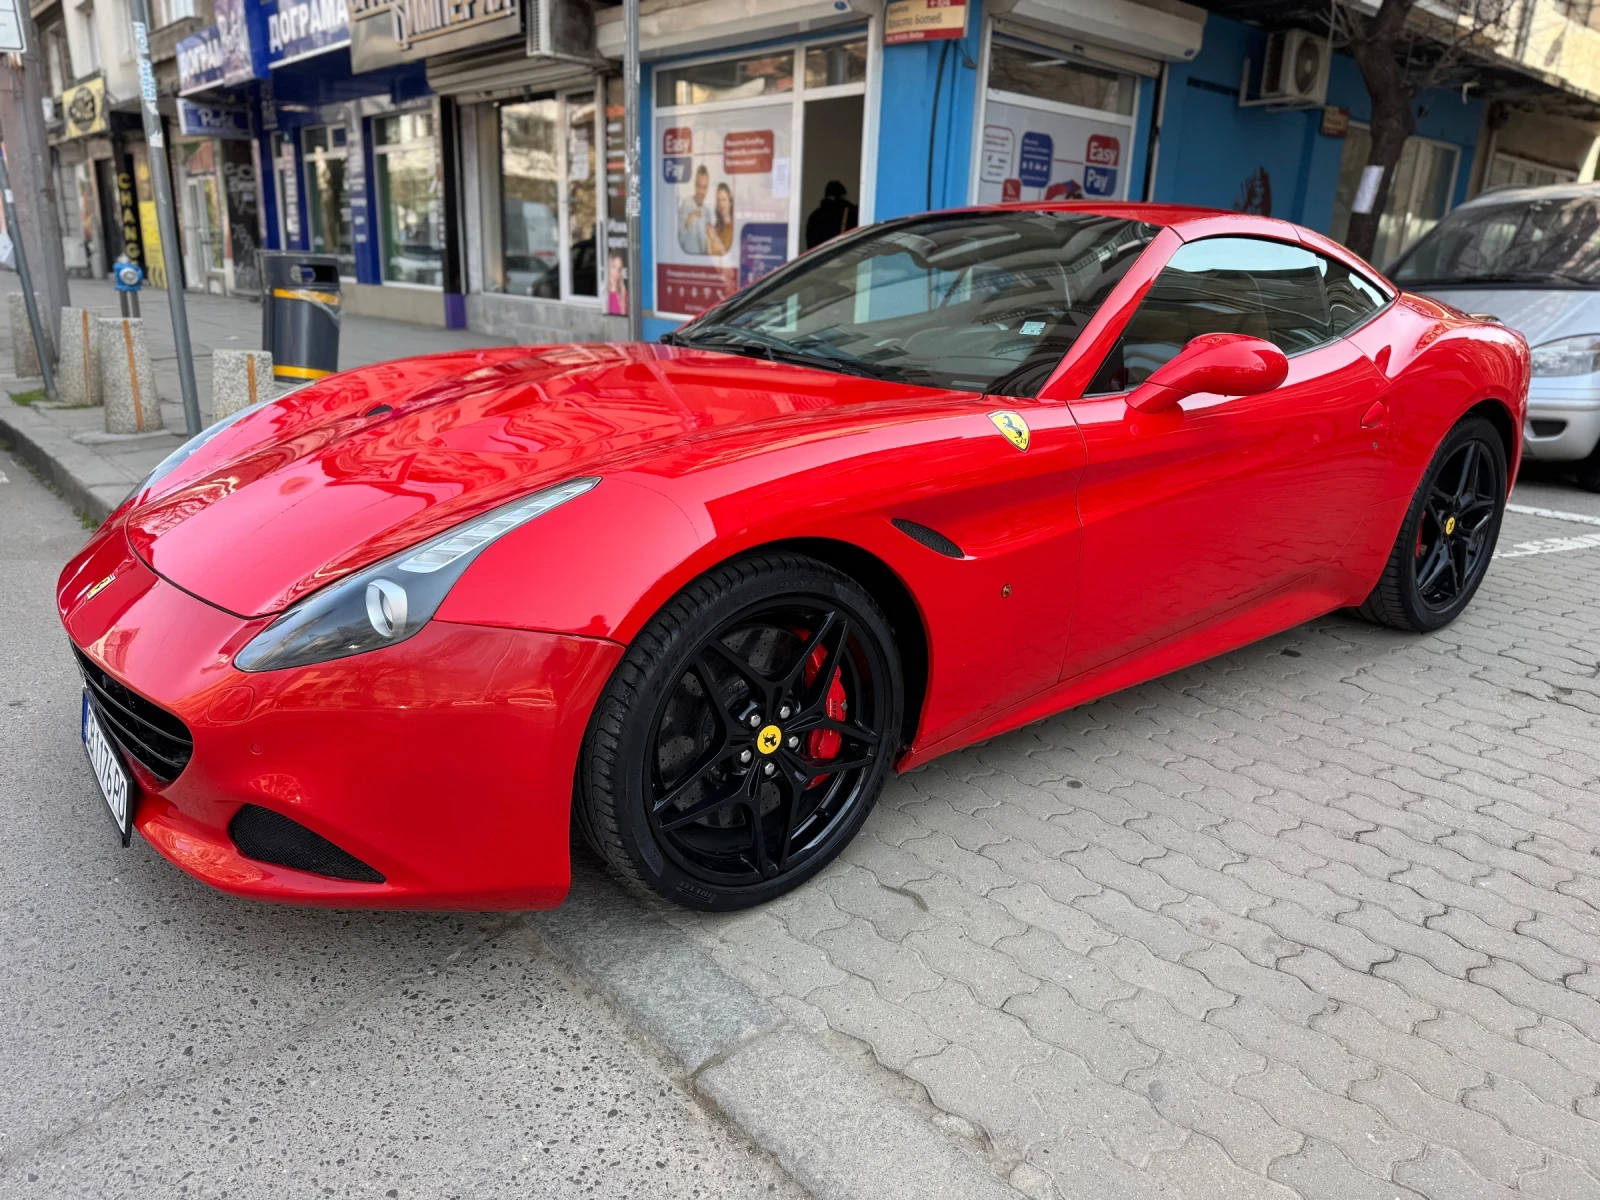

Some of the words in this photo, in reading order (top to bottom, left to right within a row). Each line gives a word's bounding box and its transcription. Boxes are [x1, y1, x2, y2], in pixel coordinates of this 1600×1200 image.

[268, 0, 349, 54] ДОГРАМА
[665, 135, 690, 154] Easy
[1089, 141, 1118, 166] Easy
[665, 160, 685, 181] Pay
[1086, 169, 1109, 193] Pay
[118, 172, 141, 264] CHANG
